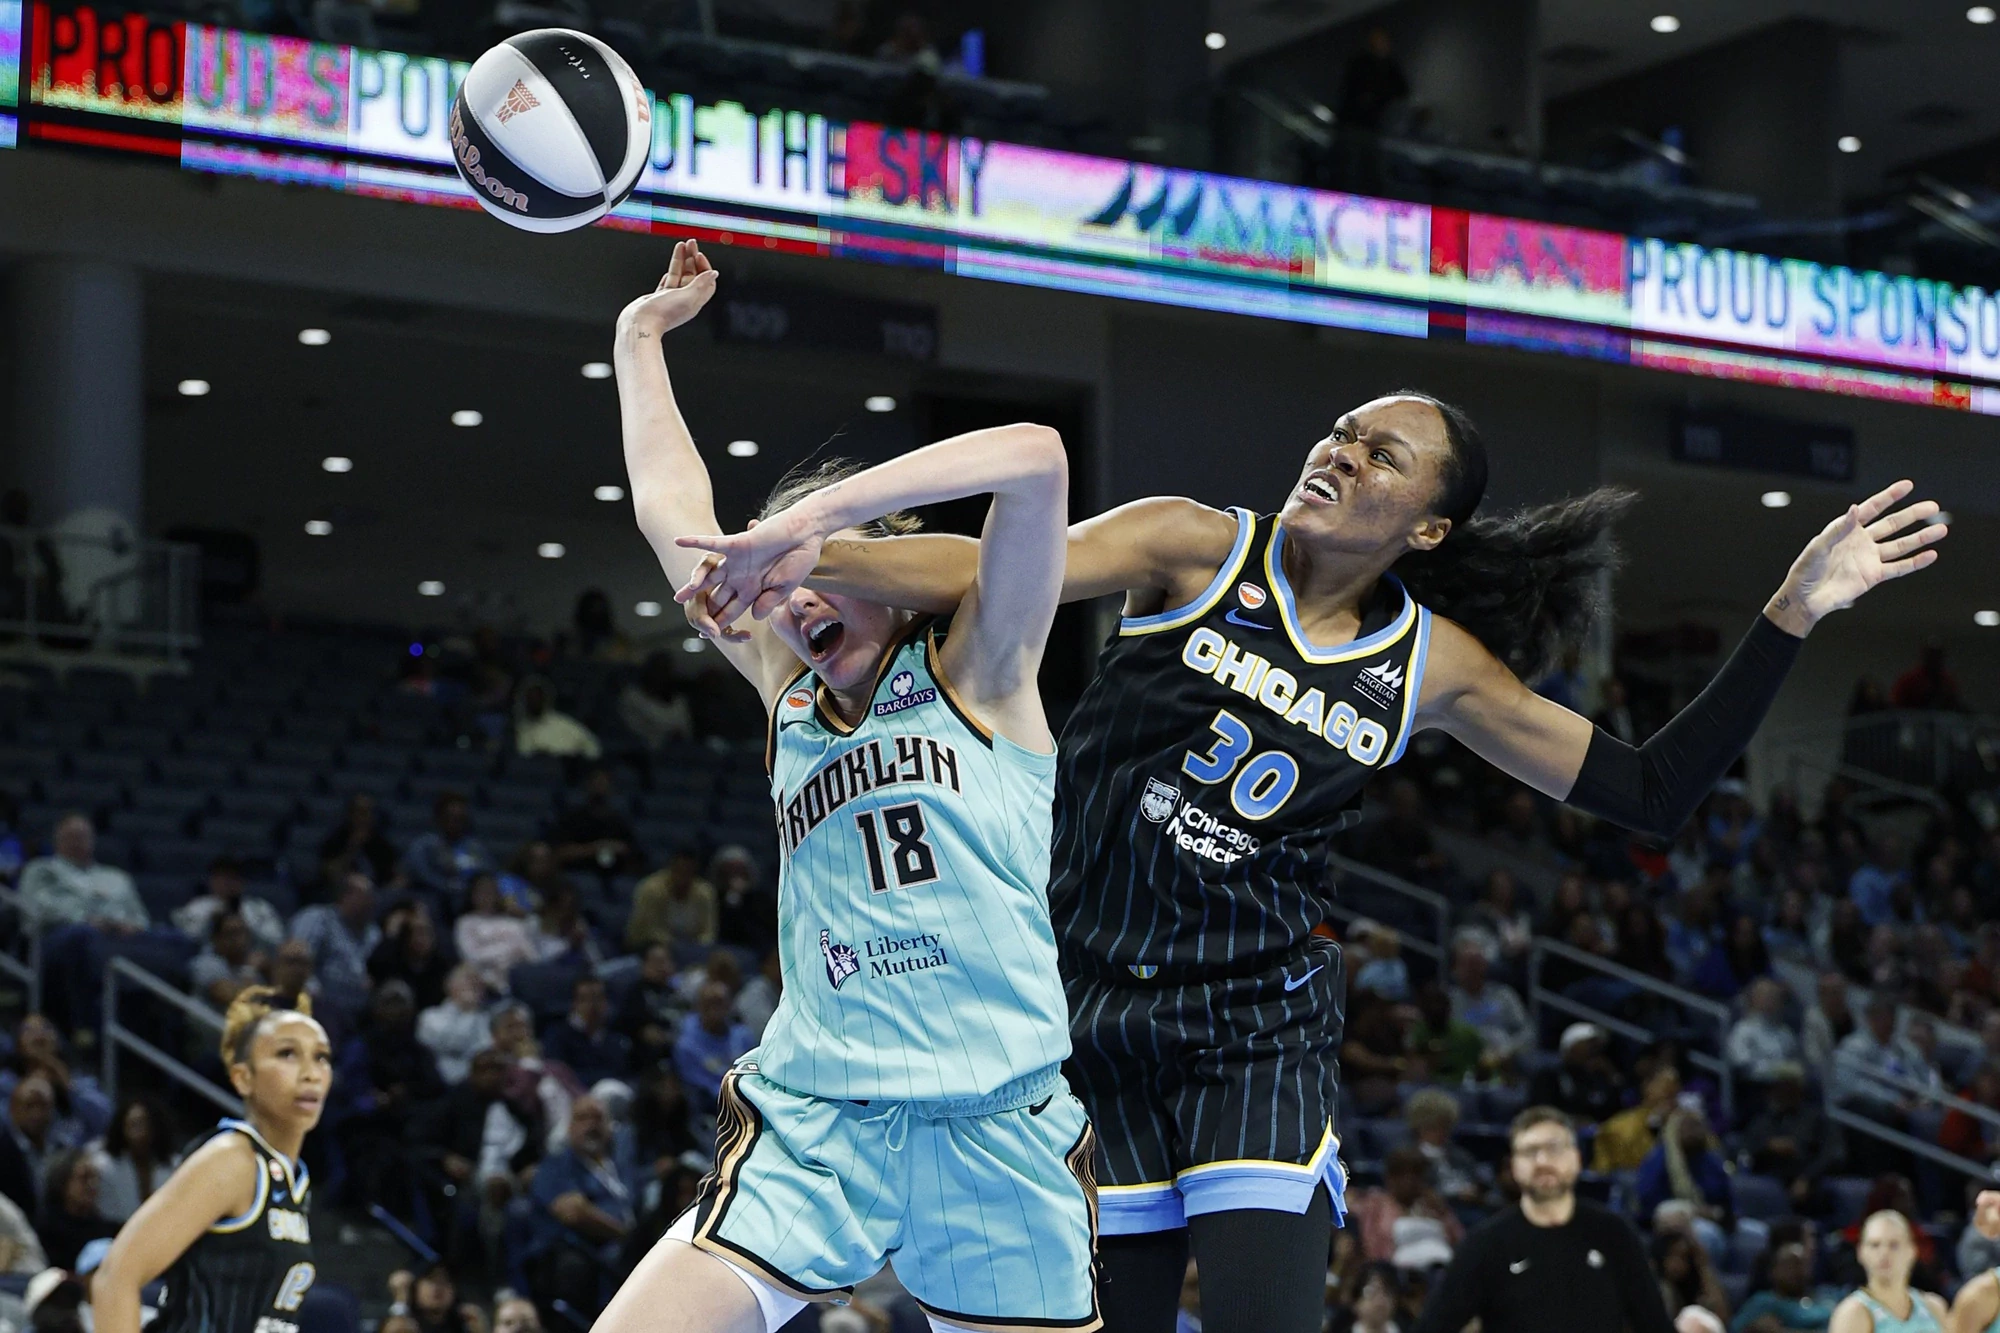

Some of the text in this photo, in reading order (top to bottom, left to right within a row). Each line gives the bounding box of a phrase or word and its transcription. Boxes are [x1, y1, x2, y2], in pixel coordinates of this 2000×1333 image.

[48, 8, 273, 118] PROUD
[743, 102, 849, 198] THE
[880, 126, 985, 217] SKY
[451, 98, 529, 212] Wilson
[1626, 236, 1788, 328] PROUD
[876, 689, 935, 715] BARCLAYS
[1182, 626, 1388, 766] CHICAGO
[1357, 672, 1397, 702] MAGELLAN
[1181, 709, 1299, 820] 30
[854, 800, 941, 895] 18
[1166, 816, 1243, 864] Medici
[864, 933, 941, 958] Liberty
[870, 948, 949, 979] Mutual
